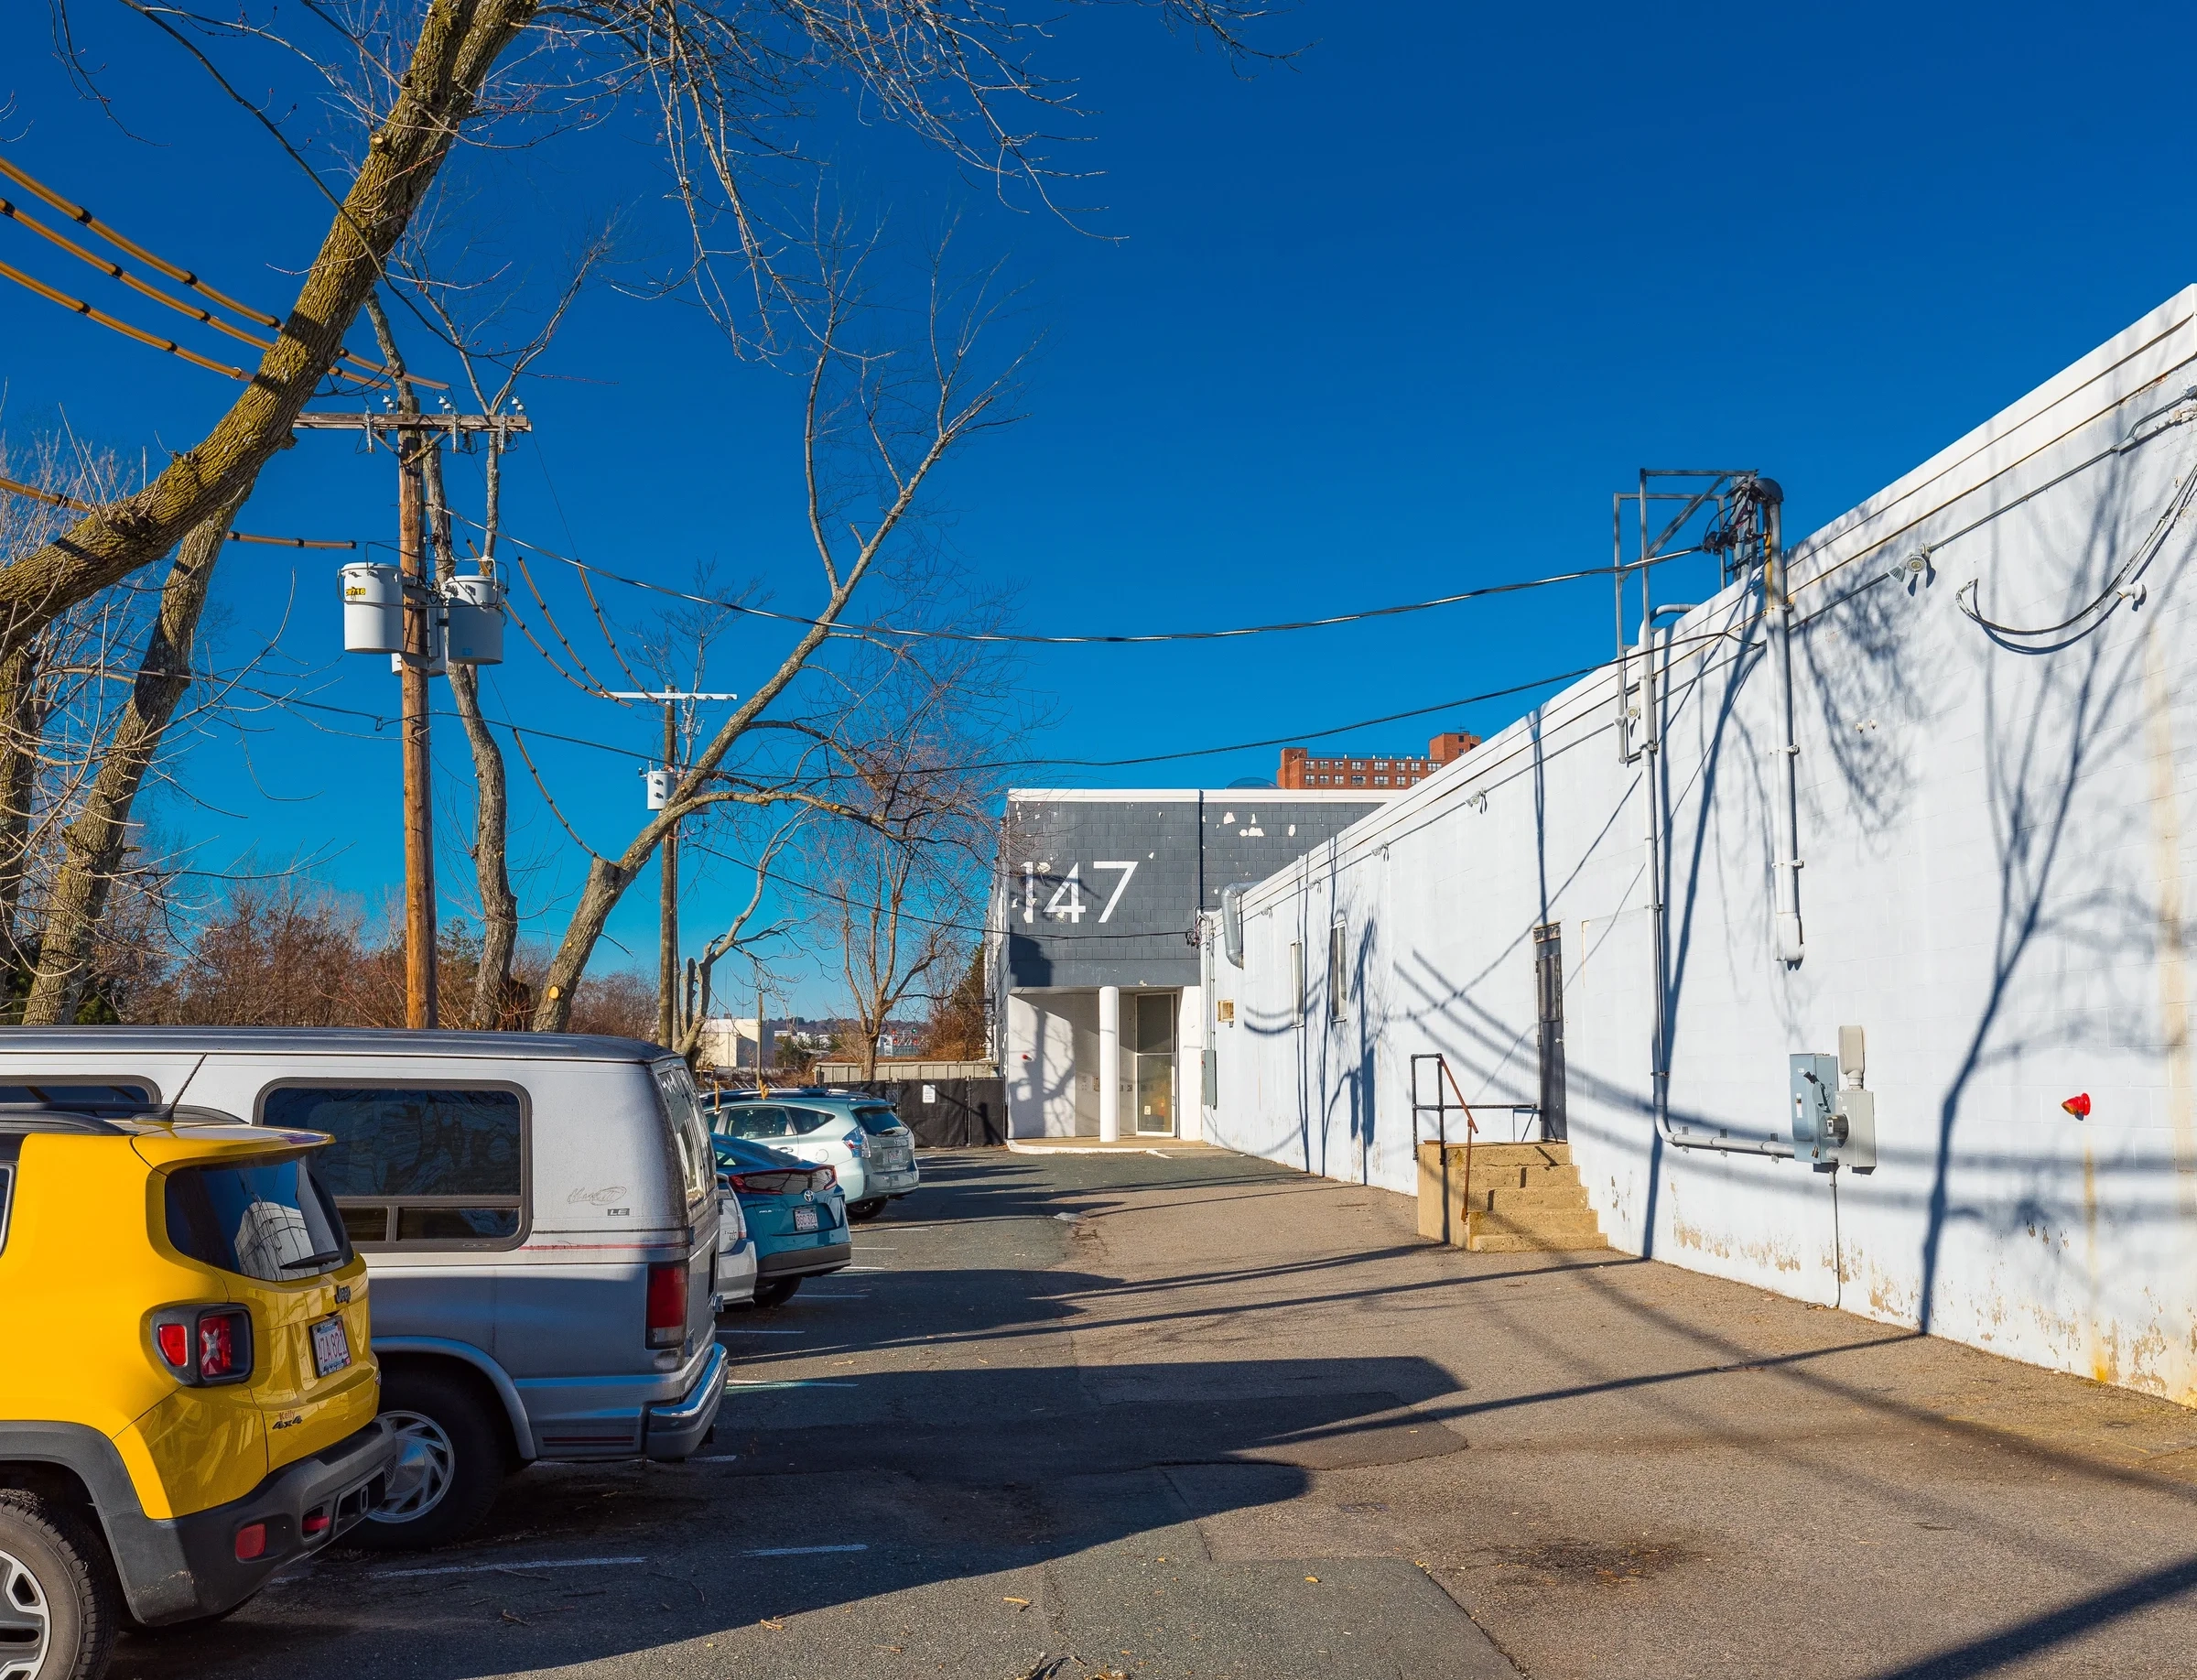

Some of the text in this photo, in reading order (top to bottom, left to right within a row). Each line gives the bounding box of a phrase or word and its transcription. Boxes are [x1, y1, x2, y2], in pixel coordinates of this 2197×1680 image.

[1021, 861, 1139, 924] 147
[335, 1284, 352, 1304] Jeep
[279, 1410, 296, 1421] Kelly
